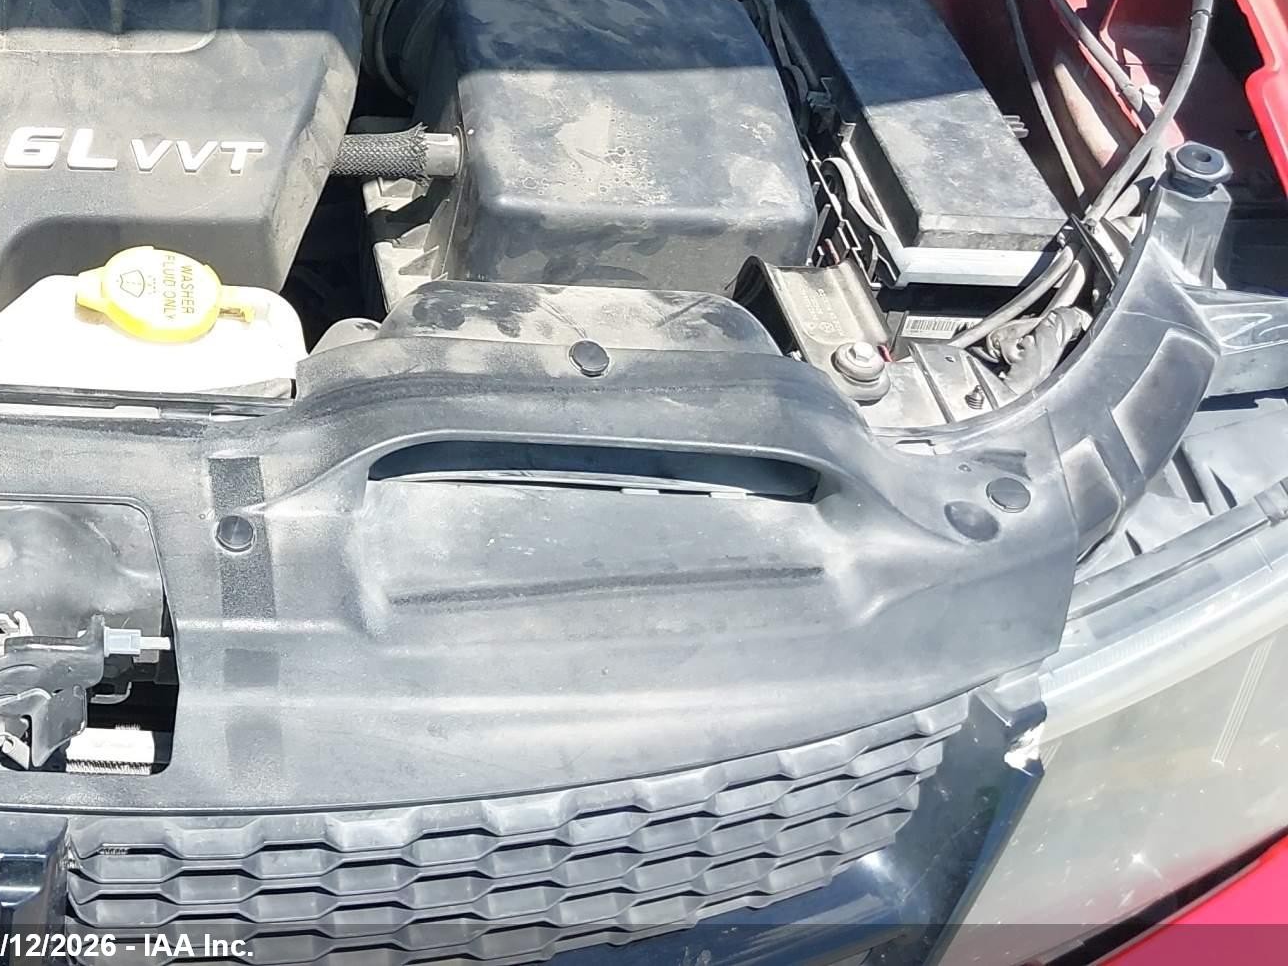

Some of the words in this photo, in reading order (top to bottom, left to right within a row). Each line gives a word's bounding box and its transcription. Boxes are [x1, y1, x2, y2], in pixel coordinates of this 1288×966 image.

[130, 138, 265, 175] VVT
[162, 254, 177, 287] FLUID
[162, 290, 177, 320] ONLY
[180, 264, 196, 315] WASHER
